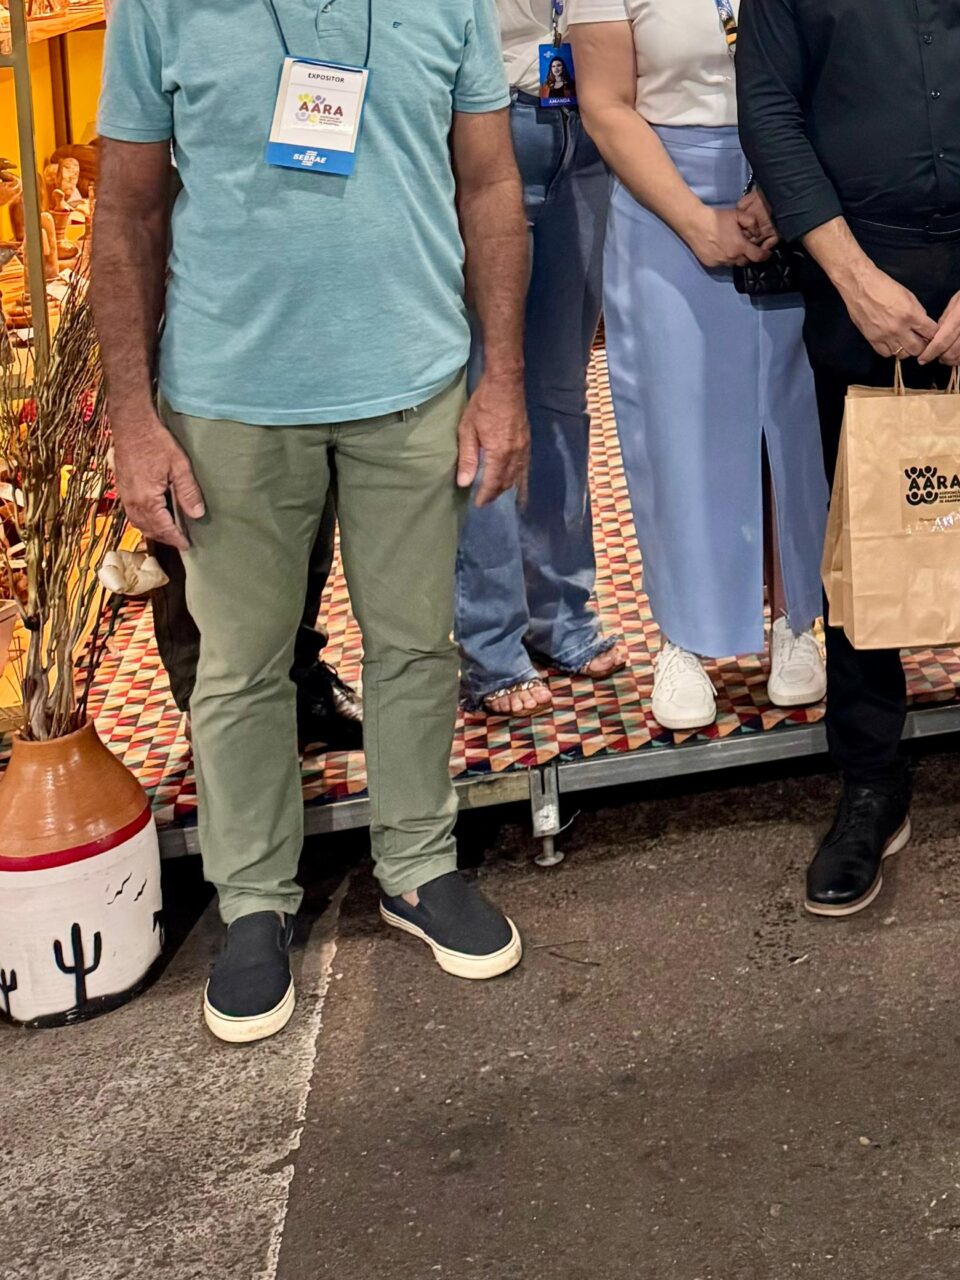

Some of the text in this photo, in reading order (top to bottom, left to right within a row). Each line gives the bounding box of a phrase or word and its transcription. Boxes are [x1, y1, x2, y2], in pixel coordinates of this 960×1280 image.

[308, 72, 345, 83] EXPOSITOR
[299, 101, 344, 117] AARA
[293, 153, 327, 164] SEBRAE
